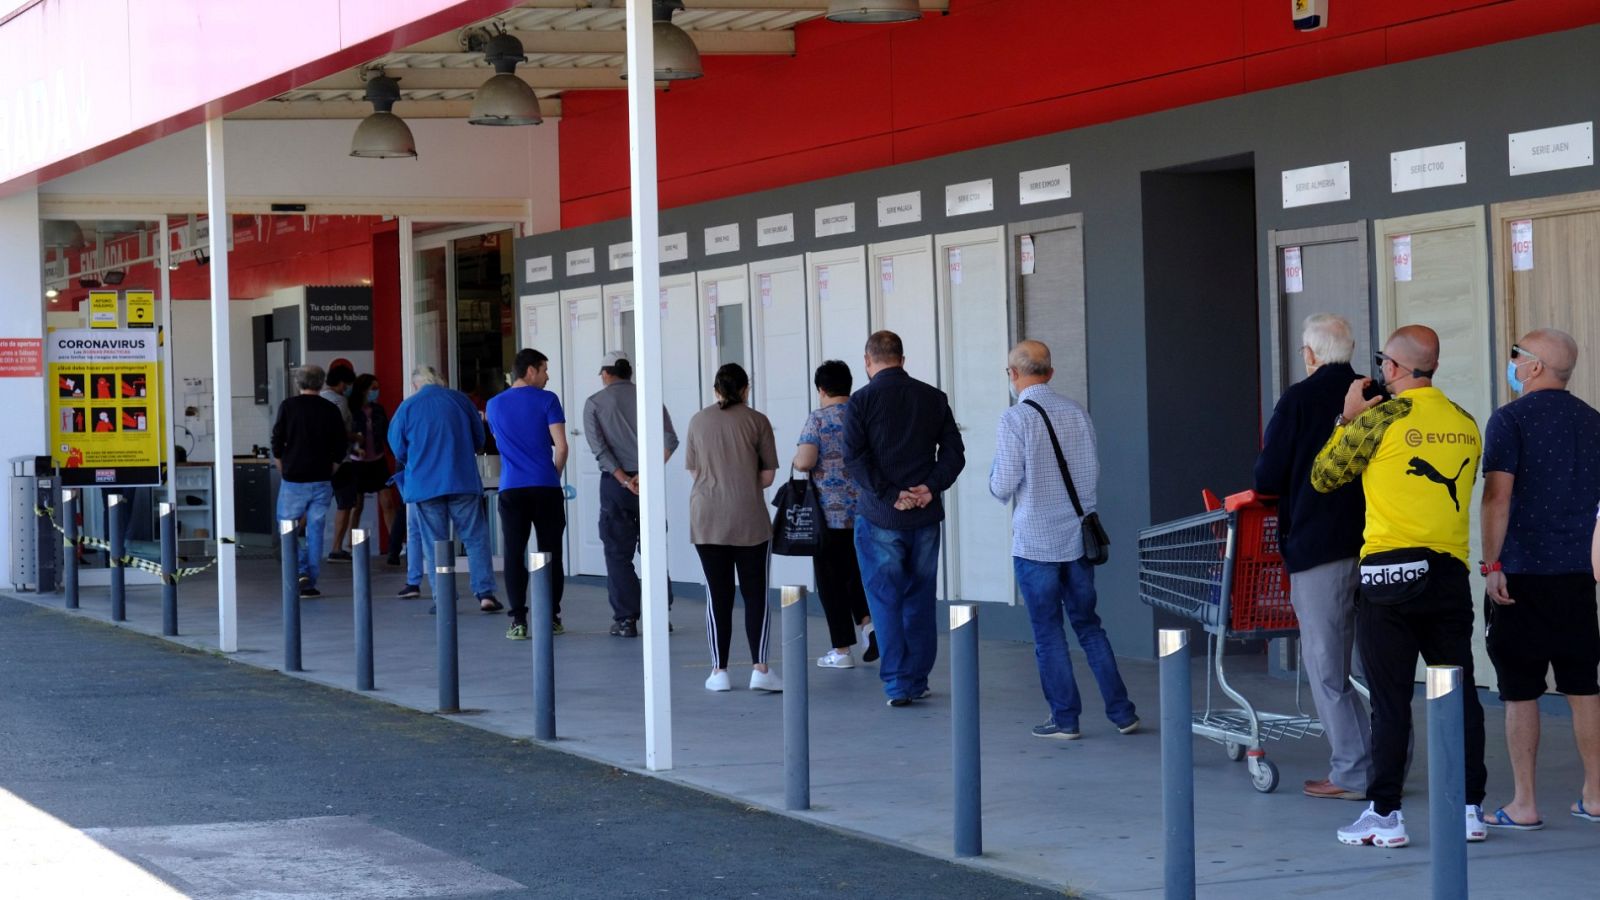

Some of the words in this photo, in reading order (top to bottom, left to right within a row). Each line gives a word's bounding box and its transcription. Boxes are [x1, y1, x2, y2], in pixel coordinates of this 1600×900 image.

[1531, 145, 1550, 156] SERIE
[1552, 142, 1569, 153] JAEN
[1410, 164, 1427, 174] SERIE
[1296, 182, 1310, 192] SERIE
[310, 303, 319, 311] Tu
[321, 303, 347, 311] cocina
[335, 313, 342, 321] la
[310, 323, 352, 333] imaginado
[58, 339, 145, 349] CORONAVIRUS
[1426, 433, 1477, 445] EVONIK
[1363, 567, 1425, 585] adidas
